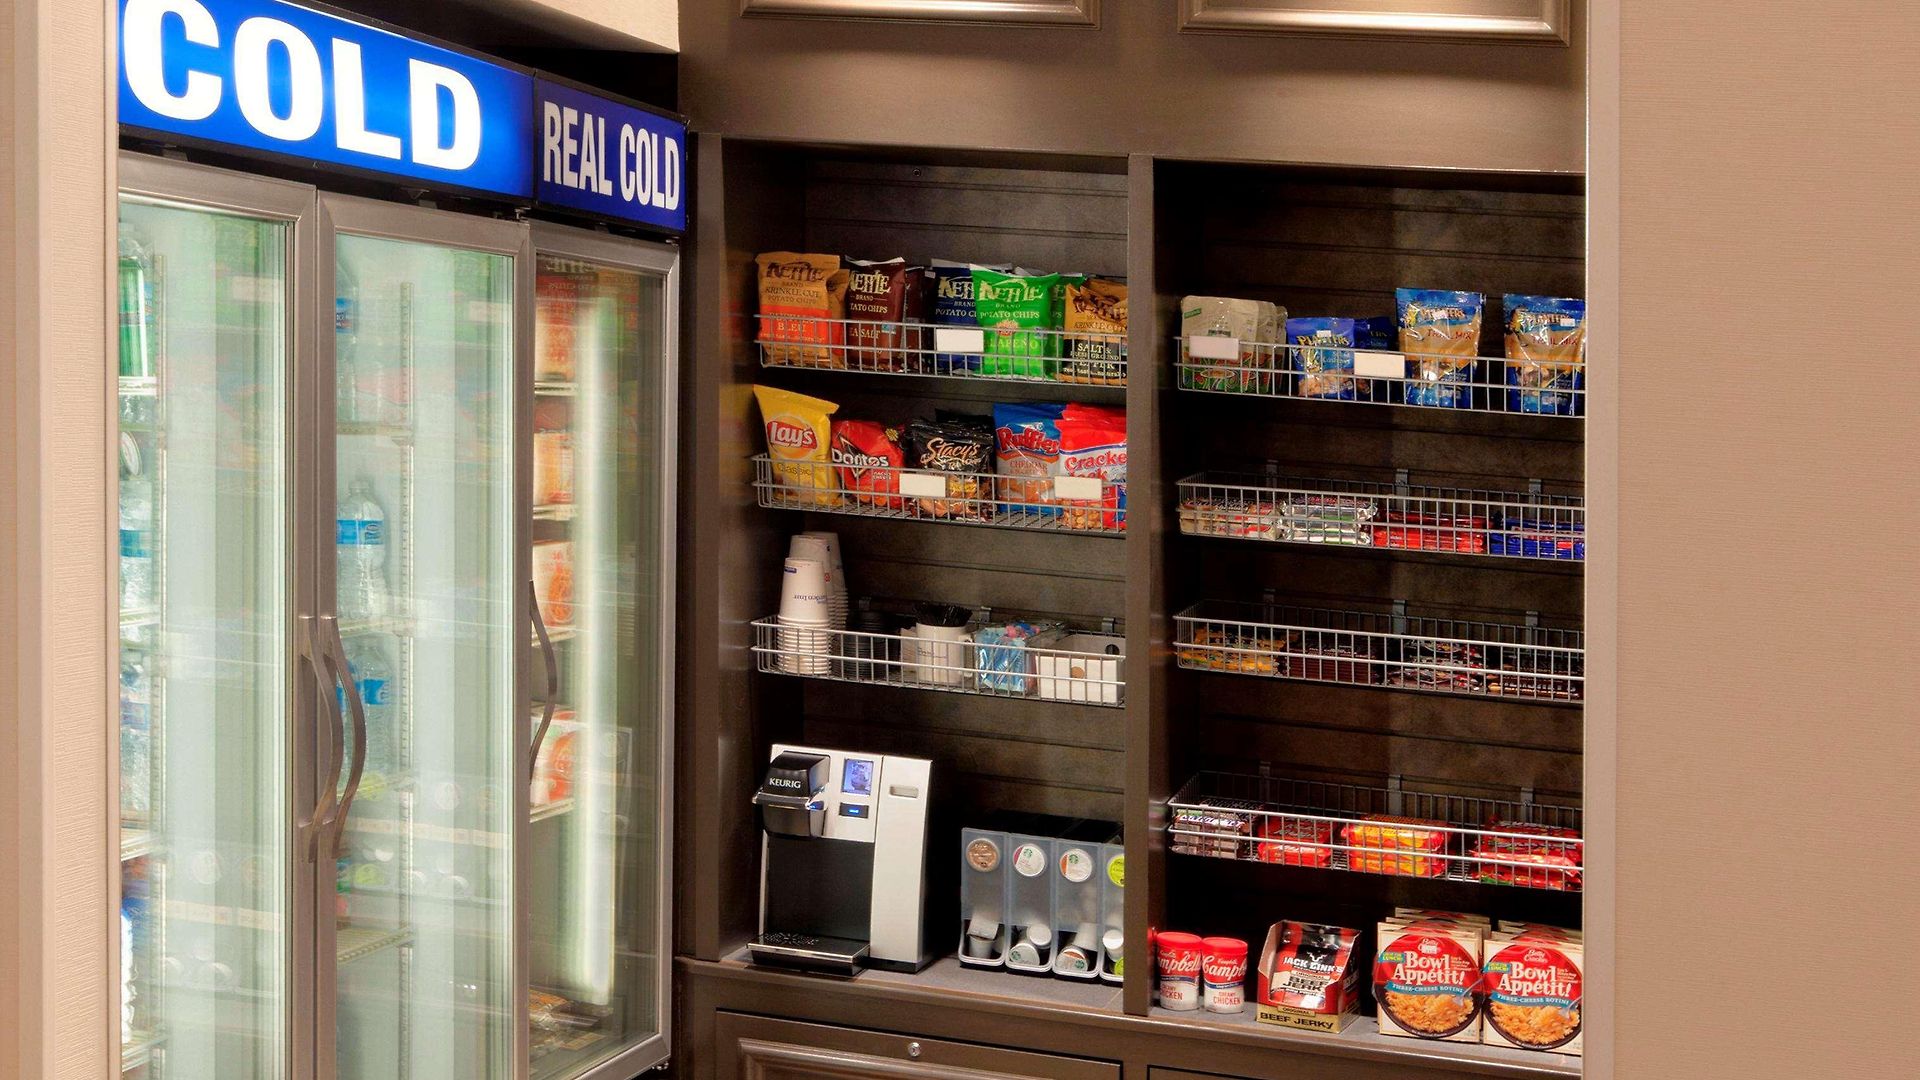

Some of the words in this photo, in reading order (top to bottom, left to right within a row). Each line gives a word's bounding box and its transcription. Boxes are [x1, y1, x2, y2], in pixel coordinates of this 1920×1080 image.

[122, 0, 482, 172] COLD
[542, 101, 613, 196] REAL
[620, 123, 680, 211] COLD
[850, 303, 867, 312] TATO
[867, 304, 888, 314] CHIPS
[935, 308, 967, 317] POTATO
[980, 310, 1011, 319] POTATO
[1012, 311, 1040, 319] CHIPS
[1455, 331, 1472, 341] MIX
[1077, 342, 1104, 354] SALT
[770, 421, 813, 448] Lay's
[996, 426, 1060, 454] Ruffles
[831, 447, 889, 468] Doritos
[920, 437, 981, 464] Stacy's
[1065, 450, 1127, 472] Cracke
[768, 777, 801, 788] KEURIG
[1283, 956, 1308, 968] JACK
[1403, 950, 1451, 971] Bowl
[1391, 963, 1466, 986] Appétit!
[1509, 961, 1557, 982] Bowl
[1392, 983, 1438, 993] THREE-CHEESE
[1496, 973, 1572, 996] Appétit!
[1213, 996, 1241, 1006] CHICKEN
[1496, 995, 1544, 1003] THREE-CHEESE
[1546, 997, 1569, 1005] ROTINI
[1259, 1012, 1292, 1023] BEEF
[1293, 1017, 1335, 1029] JERKY
